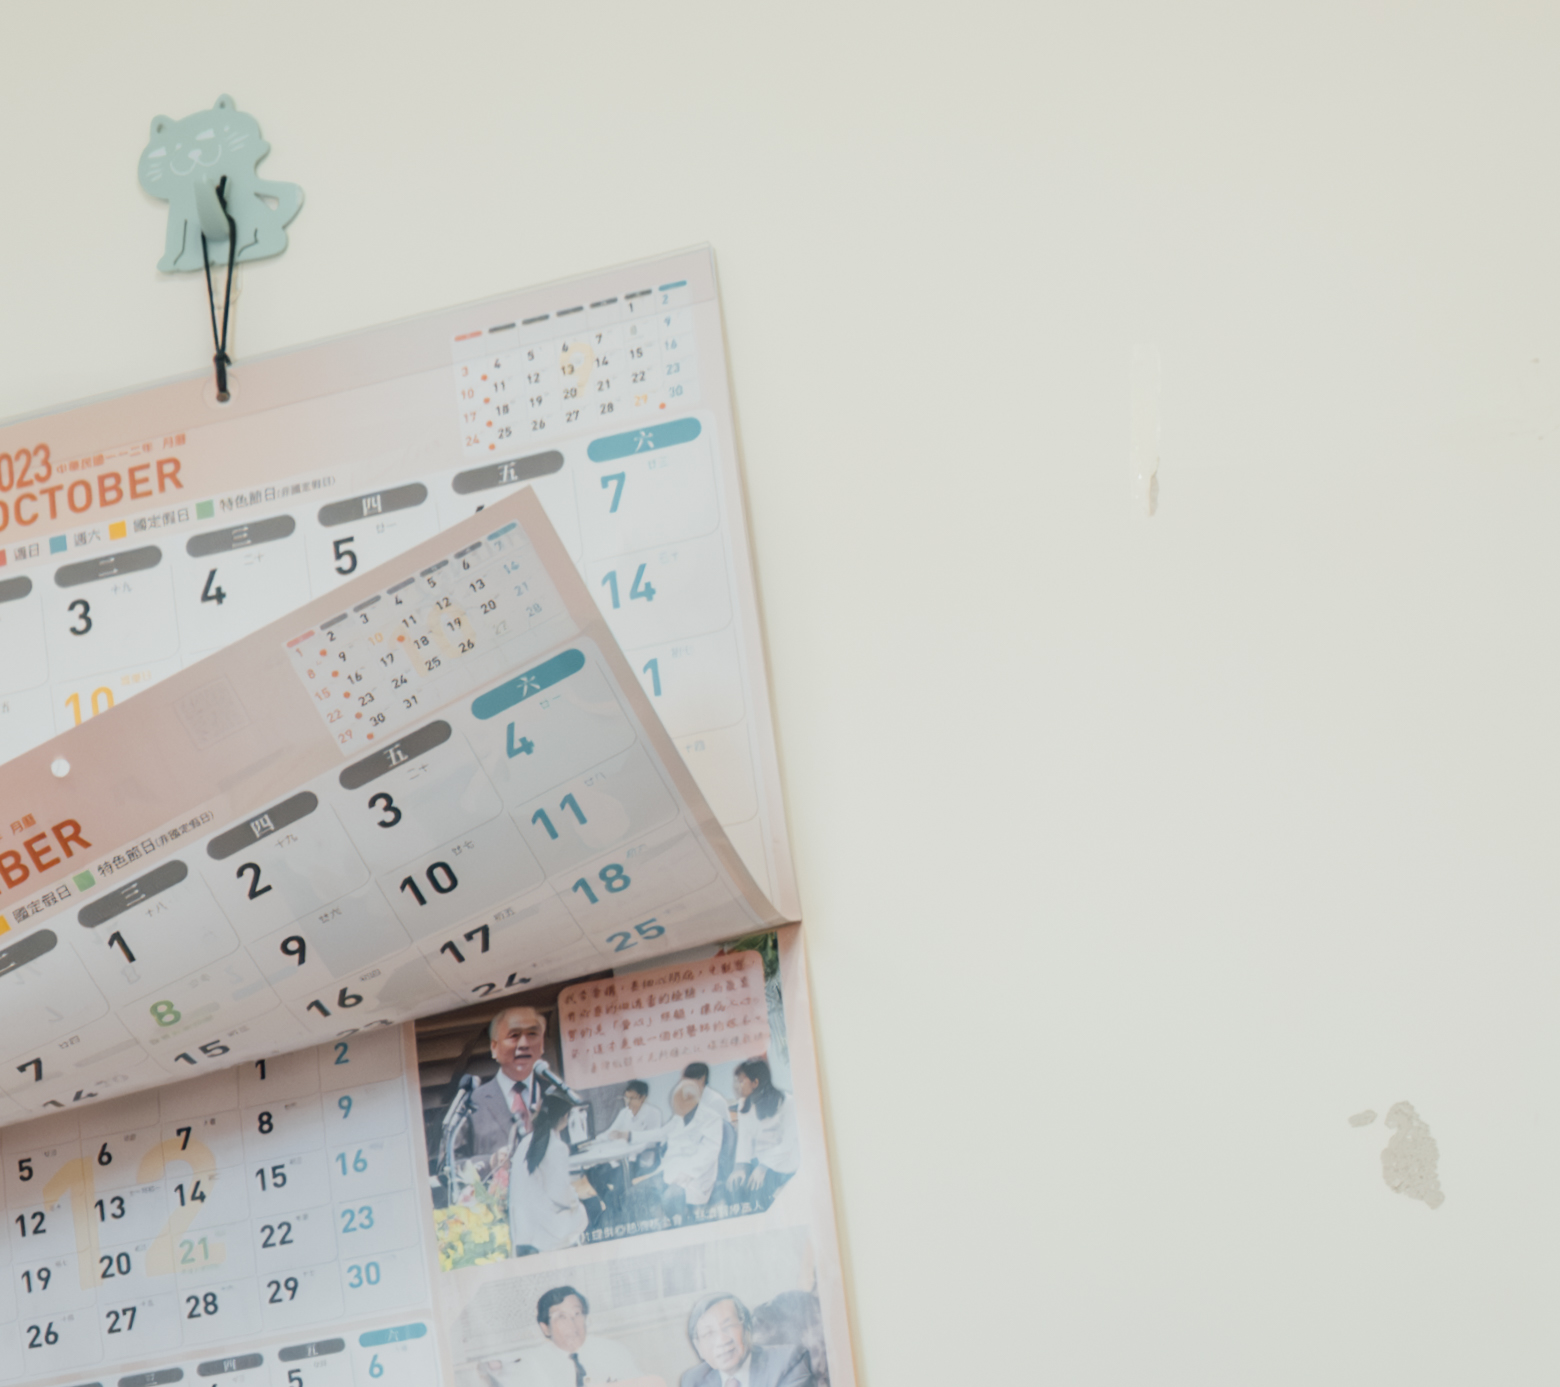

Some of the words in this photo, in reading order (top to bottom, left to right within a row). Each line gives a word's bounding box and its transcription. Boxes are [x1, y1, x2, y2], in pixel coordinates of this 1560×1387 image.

[630, 347, 643, 359] 15
[362, 495, 382, 517] 四
[498, 461, 518, 484] 五
[633, 430, 655, 451] 六
[13, 543, 42, 562] 週日
[73, 529, 101, 548] 週六
[132, 508, 191, 534] 國定假日
[67, 598, 94, 636] 3
[201, 568, 227, 606] 4
[333, 535, 358, 577] 5
[600, 472, 627, 514] 7
[601, 562, 657, 610] 14
[250, 814, 276, 838] 四
[383, 742, 410, 768] 五
[516, 675, 541, 697] 六
[108, 930, 137, 964] 1
[235, 862, 273, 901] 2
[367, 792, 404, 829] 3
[505, 721, 536, 760] 4
[12, 884, 73, 924] 國定假日
[16, 1058, 45, 1084] 7
[149, 999, 182, 1028] 8
[280, 934, 309, 966] 9
[399, 860, 460, 907] 10
[530, 793, 589, 841] 11
[605, 917, 668, 953] 25
[174, 1039, 232, 1068] 15
[306, 986, 365, 1020] 16
[440, 924, 493, 965] 17
[572, 862, 633, 906] 18
[256, 1059, 266, 1081] 1
[334, 1042, 350, 1065] 2
[18, 1158, 34, 1182] 5
[97, 1142, 113, 1166] 6
[176, 1126, 193, 1151] 7
[257, 1111, 274, 1134] 8
[338, 1095, 353, 1119] 9
[15, 1211, 47, 1238] 12
[94, 1195, 126, 1222] 13
[174, 1180, 206, 1207] 14
[256, 1164, 288, 1191] 15
[336, 1149, 368, 1176] 16
[369, 1354, 384, 1379] 6
